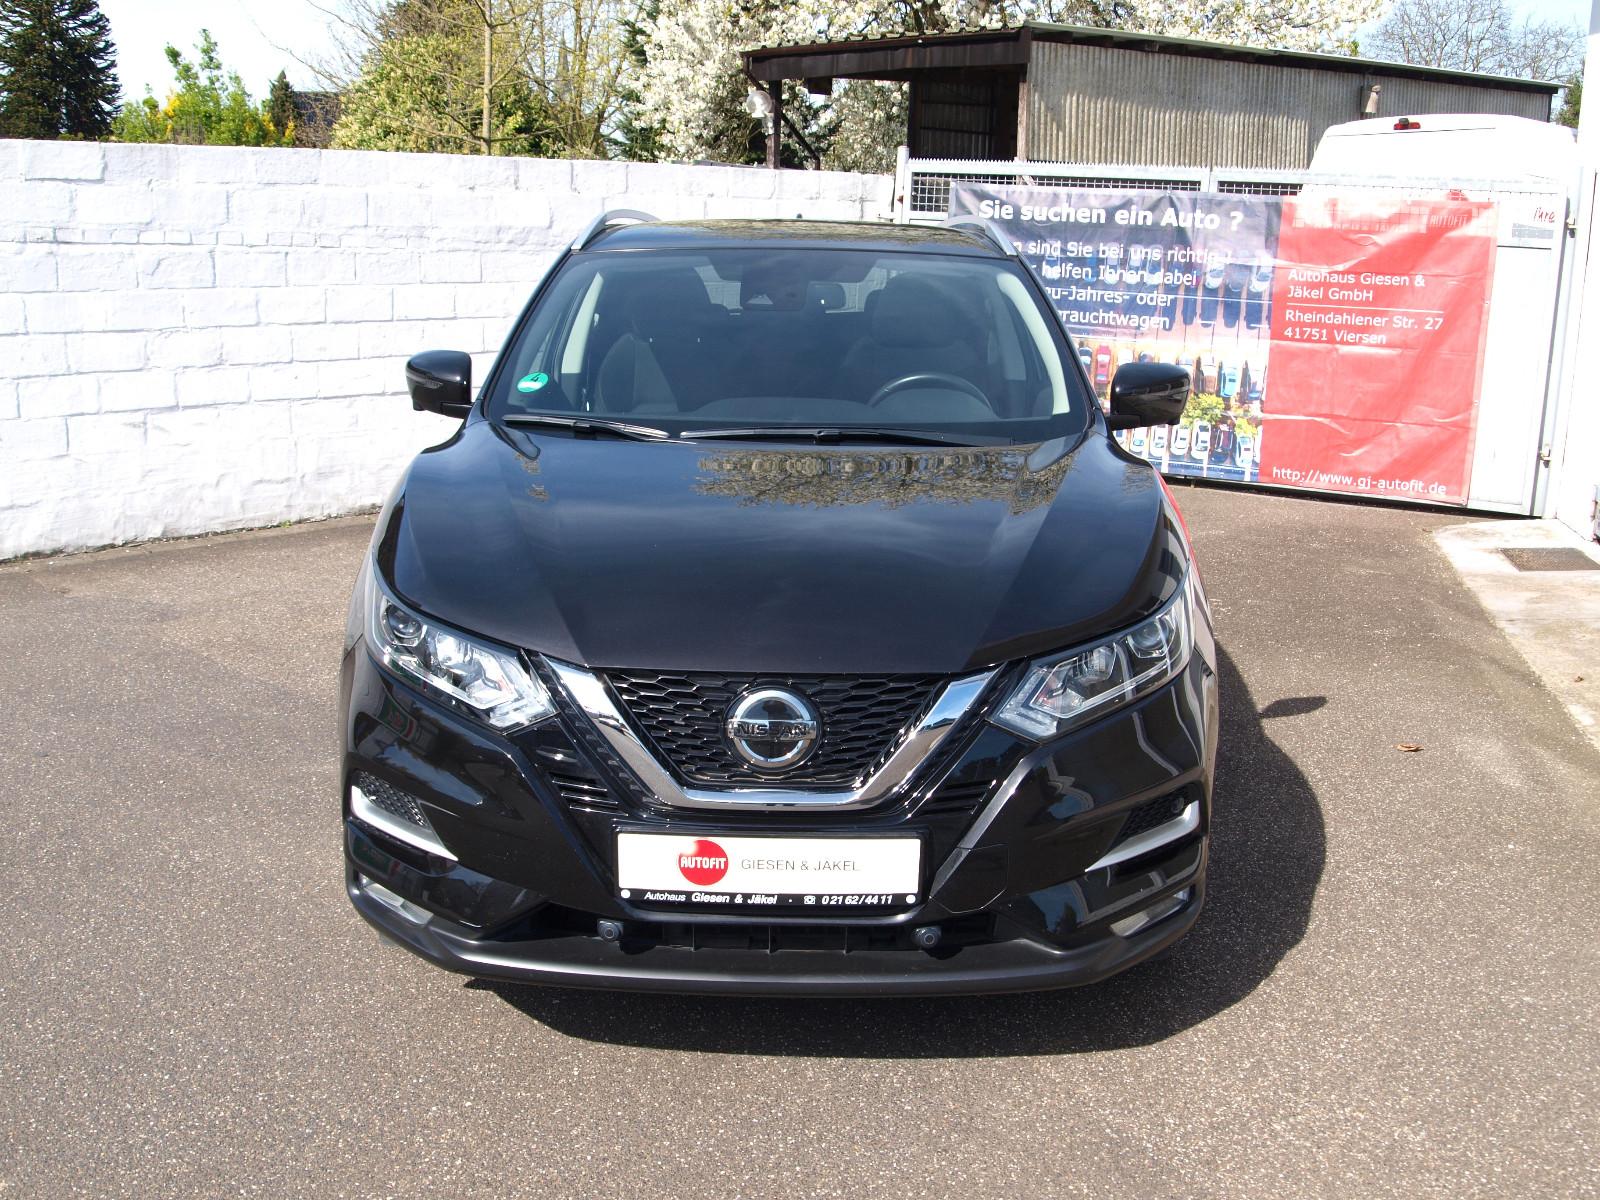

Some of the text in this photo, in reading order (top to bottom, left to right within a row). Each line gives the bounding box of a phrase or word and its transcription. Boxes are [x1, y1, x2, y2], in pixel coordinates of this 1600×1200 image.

[978, 199, 1244, 231] Sie suchen ein Auto ?
[1028, 239, 1061, 256] sind
[1066, 240, 1093, 257] Sie
[1099, 242, 1124, 260] bei
[1129, 246, 1161, 261] uns
[1041, 261, 1092, 280] helfen
[1098, 263, 1148, 282] Ihnen
[1154, 267, 1197, 286] dabei
[1287, 268, 1425, 287] Autohaus Giesen &
[1136, 291, 1175, 308] oder
[1287, 285, 1374, 302] Jäkel GmbH
[1058, 309, 1170, 332] rauchtwagen
[1285, 309, 1444, 331] Rheindahlener Str. 27
[1283, 326, 1387, 345] 41751 Viersen
[1272, 466, 1448, 495] http://www.gj-autofit.de
[680, 856, 727, 870] AUTOFIT
[741, 858, 796, 872] GIESEN
[800, 860, 809, 872] &
[644, 890, 686, 902] Autohaus
[691, 892, 730, 904] Giesen
[735, 893, 743, 904] &
[748, 894, 778, 905] Jäkel
